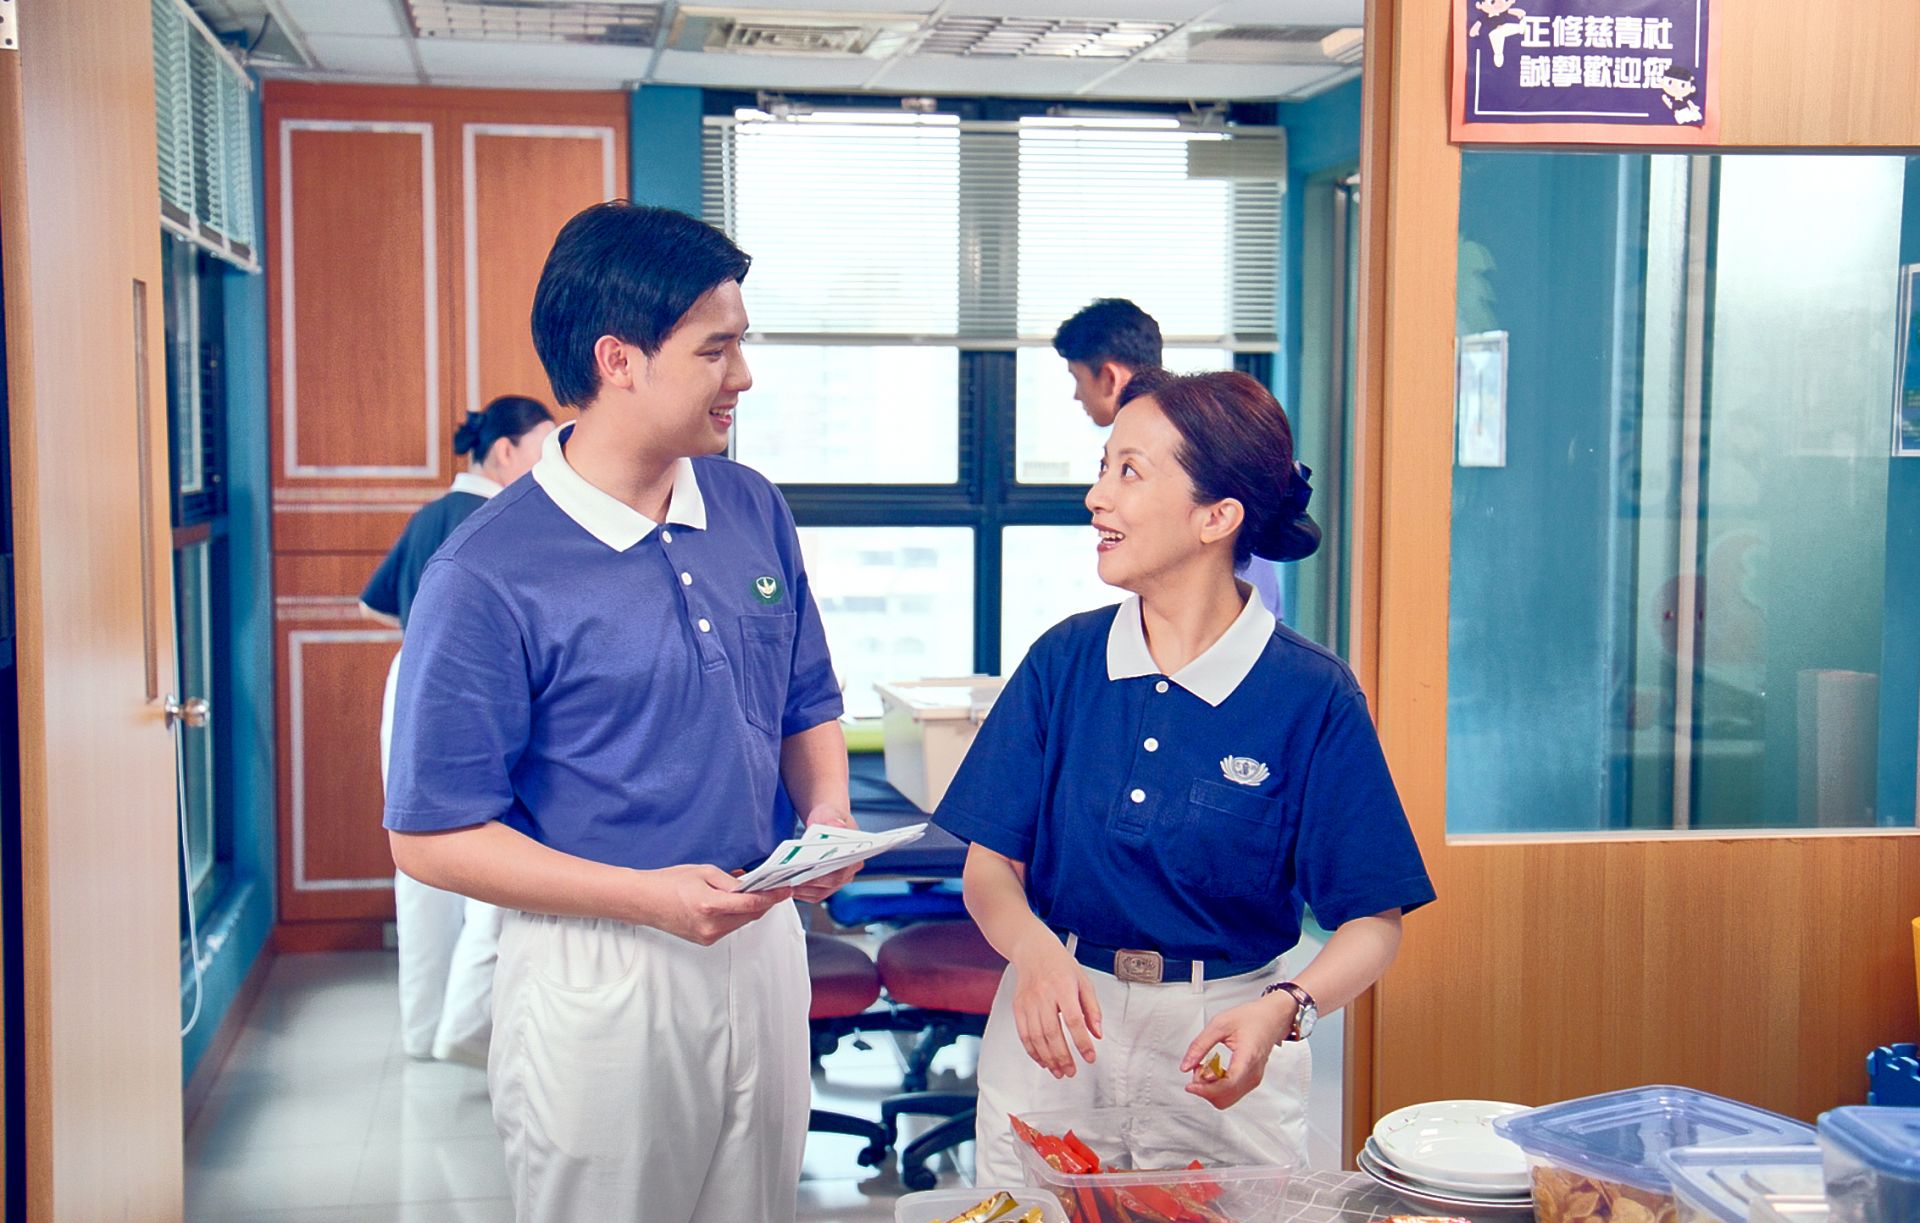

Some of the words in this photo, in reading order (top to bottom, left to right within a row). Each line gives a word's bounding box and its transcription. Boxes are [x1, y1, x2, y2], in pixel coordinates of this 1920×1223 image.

[1520, 15, 1673, 50] 正修慈青社
